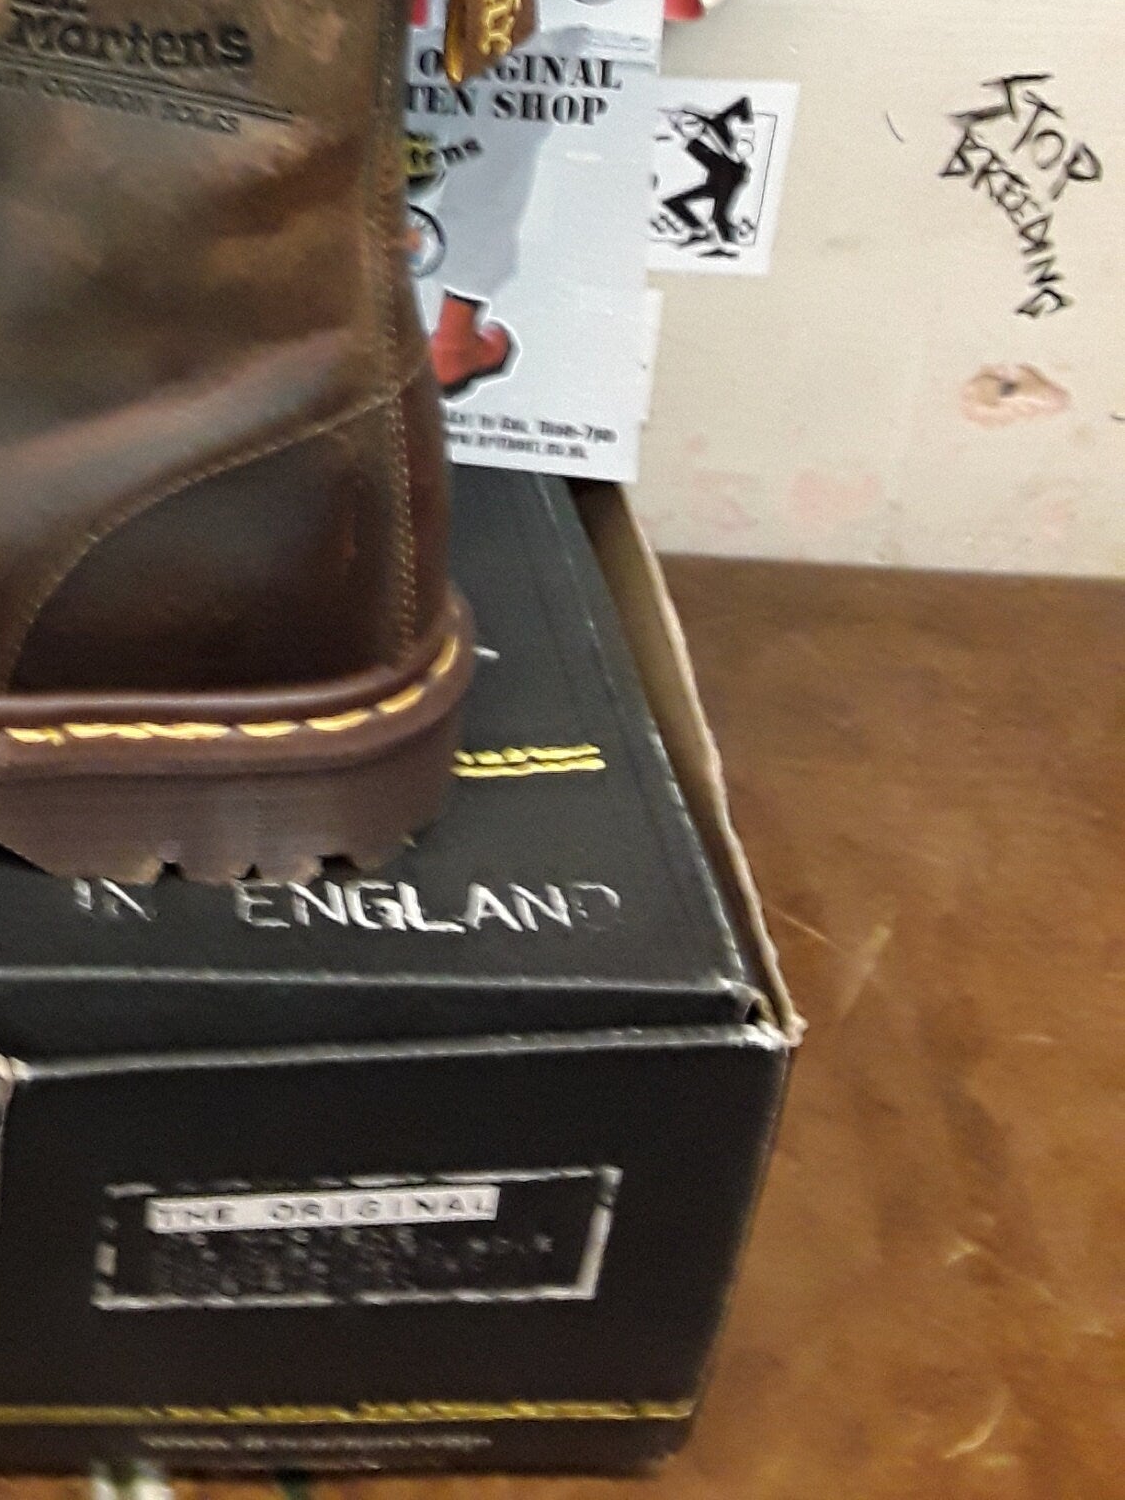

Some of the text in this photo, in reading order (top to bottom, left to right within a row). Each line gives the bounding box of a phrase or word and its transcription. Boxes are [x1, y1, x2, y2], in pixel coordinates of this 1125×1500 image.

[8, 7, 255, 67] Martens
[419, 49, 623, 91] OGINAL
[406, 84, 609, 125] TEN SHOP
[235, 880, 622, 934] ENGLAND
